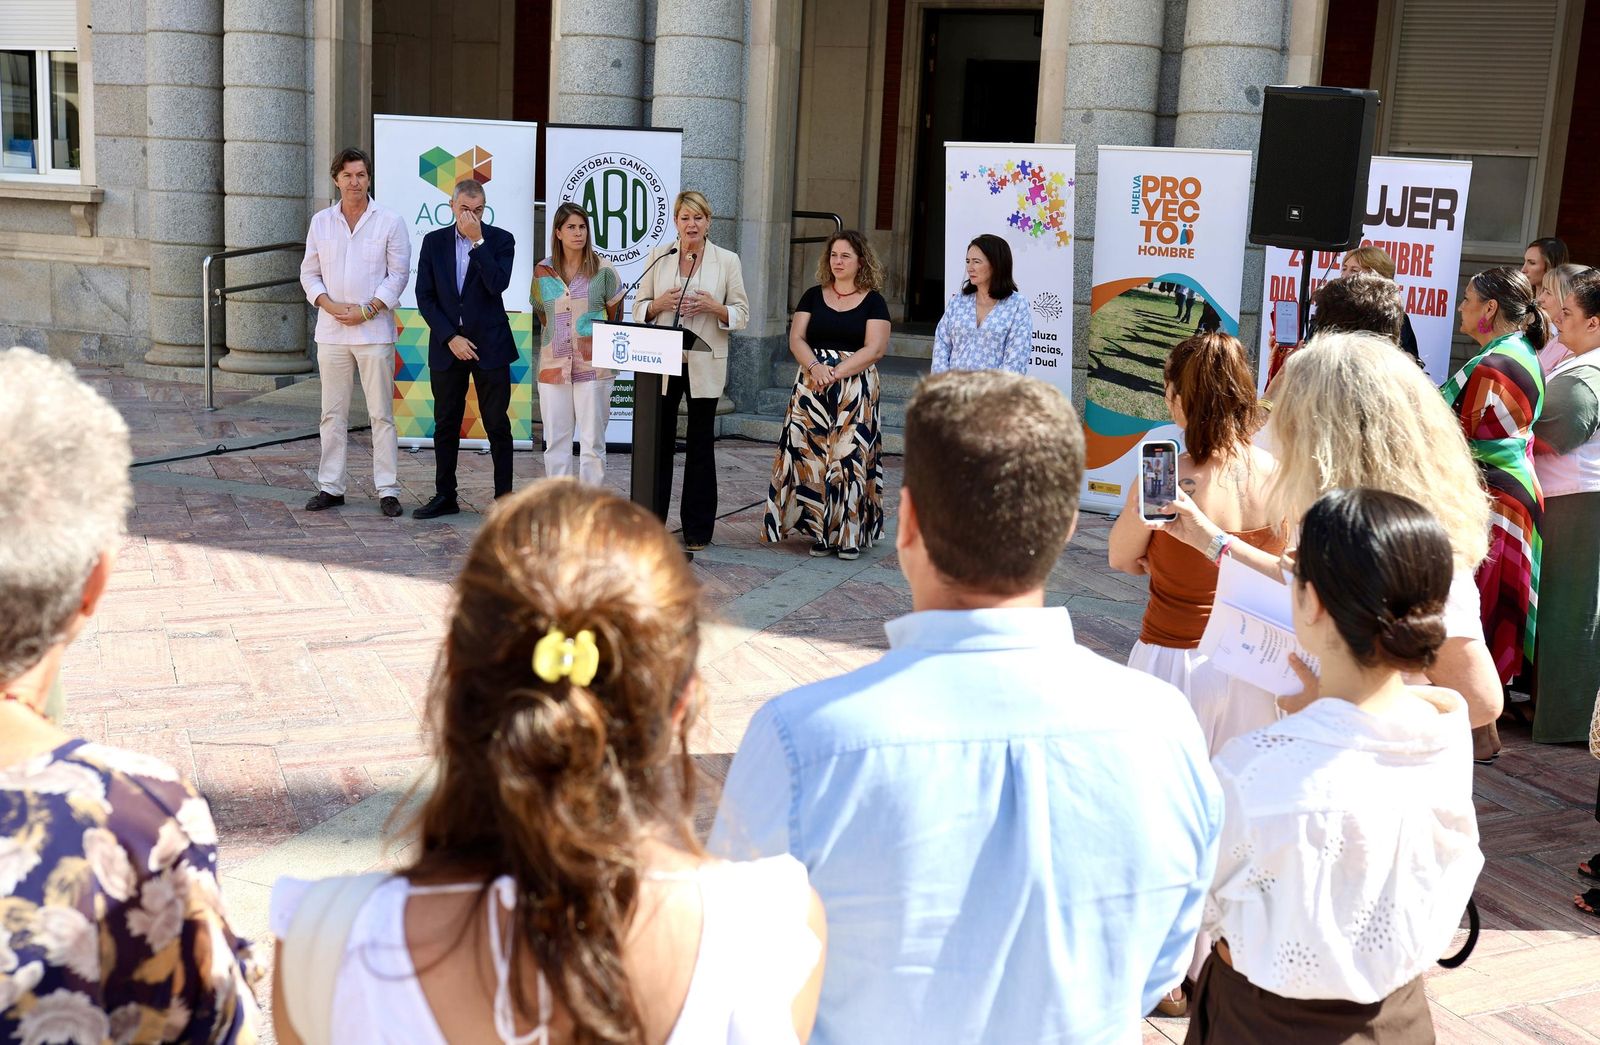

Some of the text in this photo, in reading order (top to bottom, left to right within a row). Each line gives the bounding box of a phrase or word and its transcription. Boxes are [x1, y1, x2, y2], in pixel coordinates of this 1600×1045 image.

[567, 156, 616, 191] CRISTÓBAL
[619, 157, 661, 193] GANGOSO
[651, 196, 667, 240] ARAGÓN
[1131, 175, 1142, 215] HUELVA
[1141, 175, 1202, 200] PRO
[1142, 198, 1201, 223] YEC
[1364, 185, 1459, 231] UJER
[1140, 220, 1179, 245] TO
[1138, 245, 1195, 259] HOMBRE
[1270, 275, 1297, 301] DIA
[1405, 286, 1448, 317] AZAR
[1031, 330, 1057, 341] aluza
[631, 354, 662, 364] HUELVA
[1031, 344, 1064, 357] encias,
[1035, 356, 1057, 367] Dual
